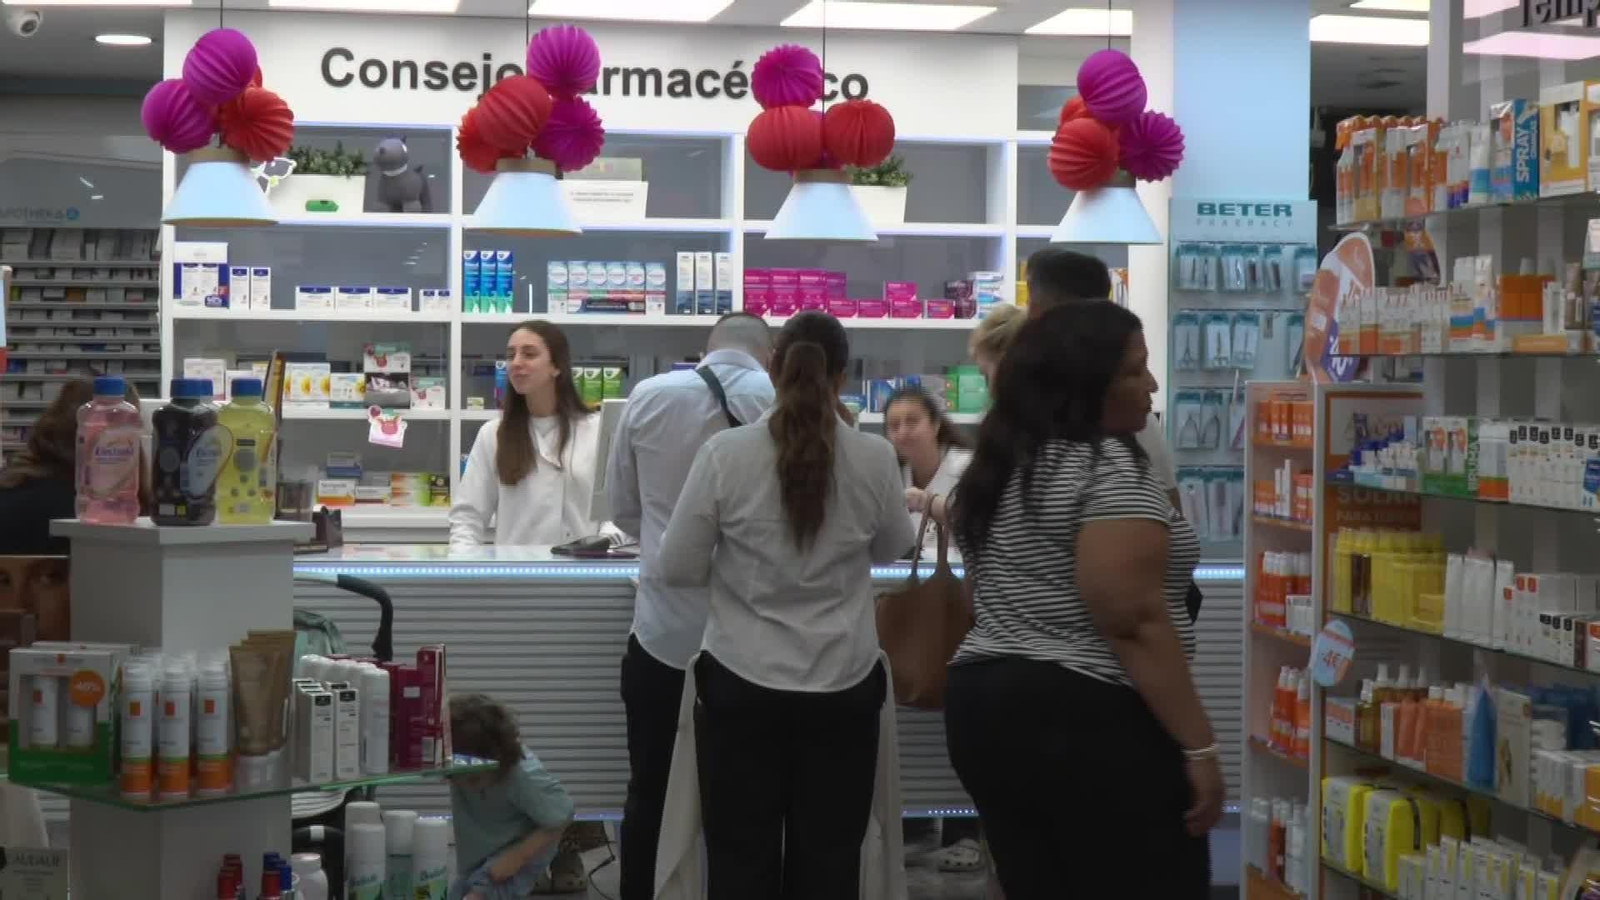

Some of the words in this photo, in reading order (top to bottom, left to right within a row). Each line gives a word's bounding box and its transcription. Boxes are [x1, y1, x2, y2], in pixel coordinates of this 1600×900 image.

[583, 60, 869, 102] rmacéco
[1516, 126, 1530, 183] SPRAY
[1196, 202, 1293, 217] BETER
